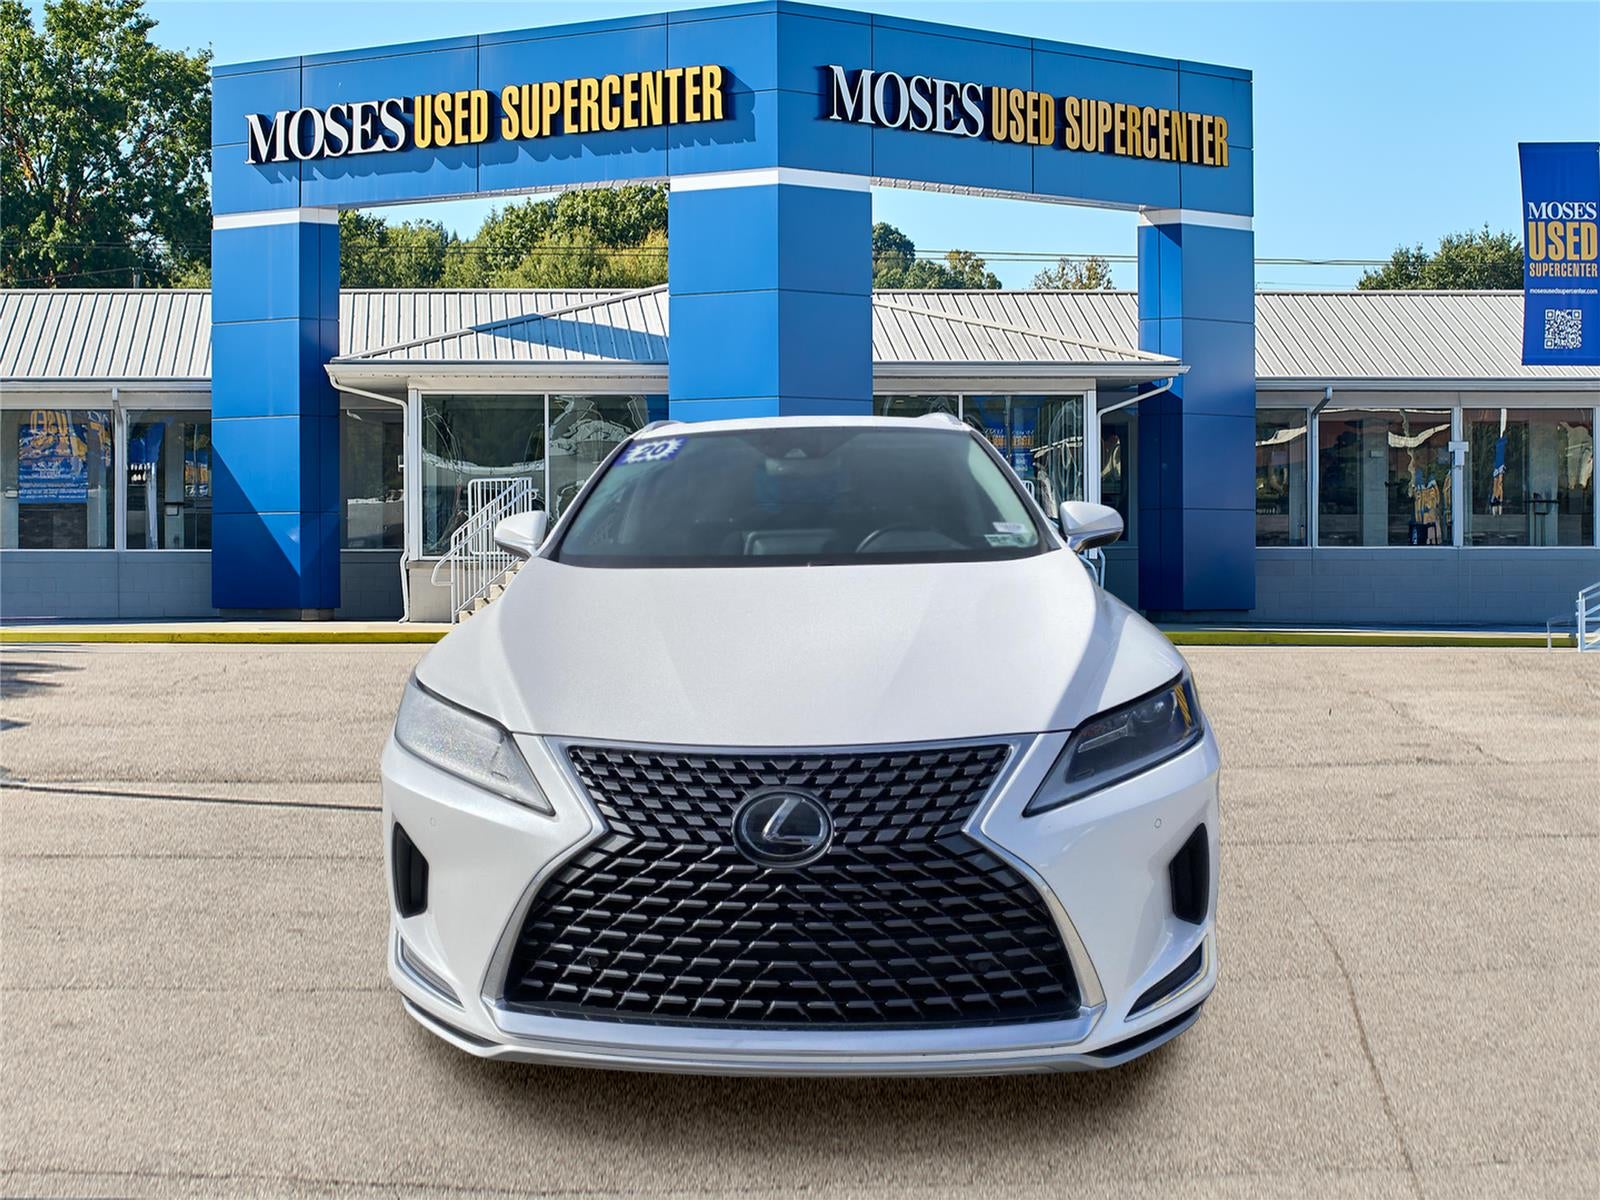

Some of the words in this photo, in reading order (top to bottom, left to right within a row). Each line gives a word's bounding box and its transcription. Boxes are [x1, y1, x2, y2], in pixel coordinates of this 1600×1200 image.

[244, 98, 407, 165] MOSES
[413, 89, 488, 149] USED
[500, 64, 723, 141] SUPERCENTER
[828, 65, 984, 138] MOSES
[991, 86, 1055, 146] USED
[1064, 96, 1229, 167] SUPERCENTER
[1528, 201, 1598, 220] MOSES
[1528, 221, 1598, 261] USED
[1529, 262, 1598, 278] SUPERCENTER
[633, 442, 671, 459] 20
